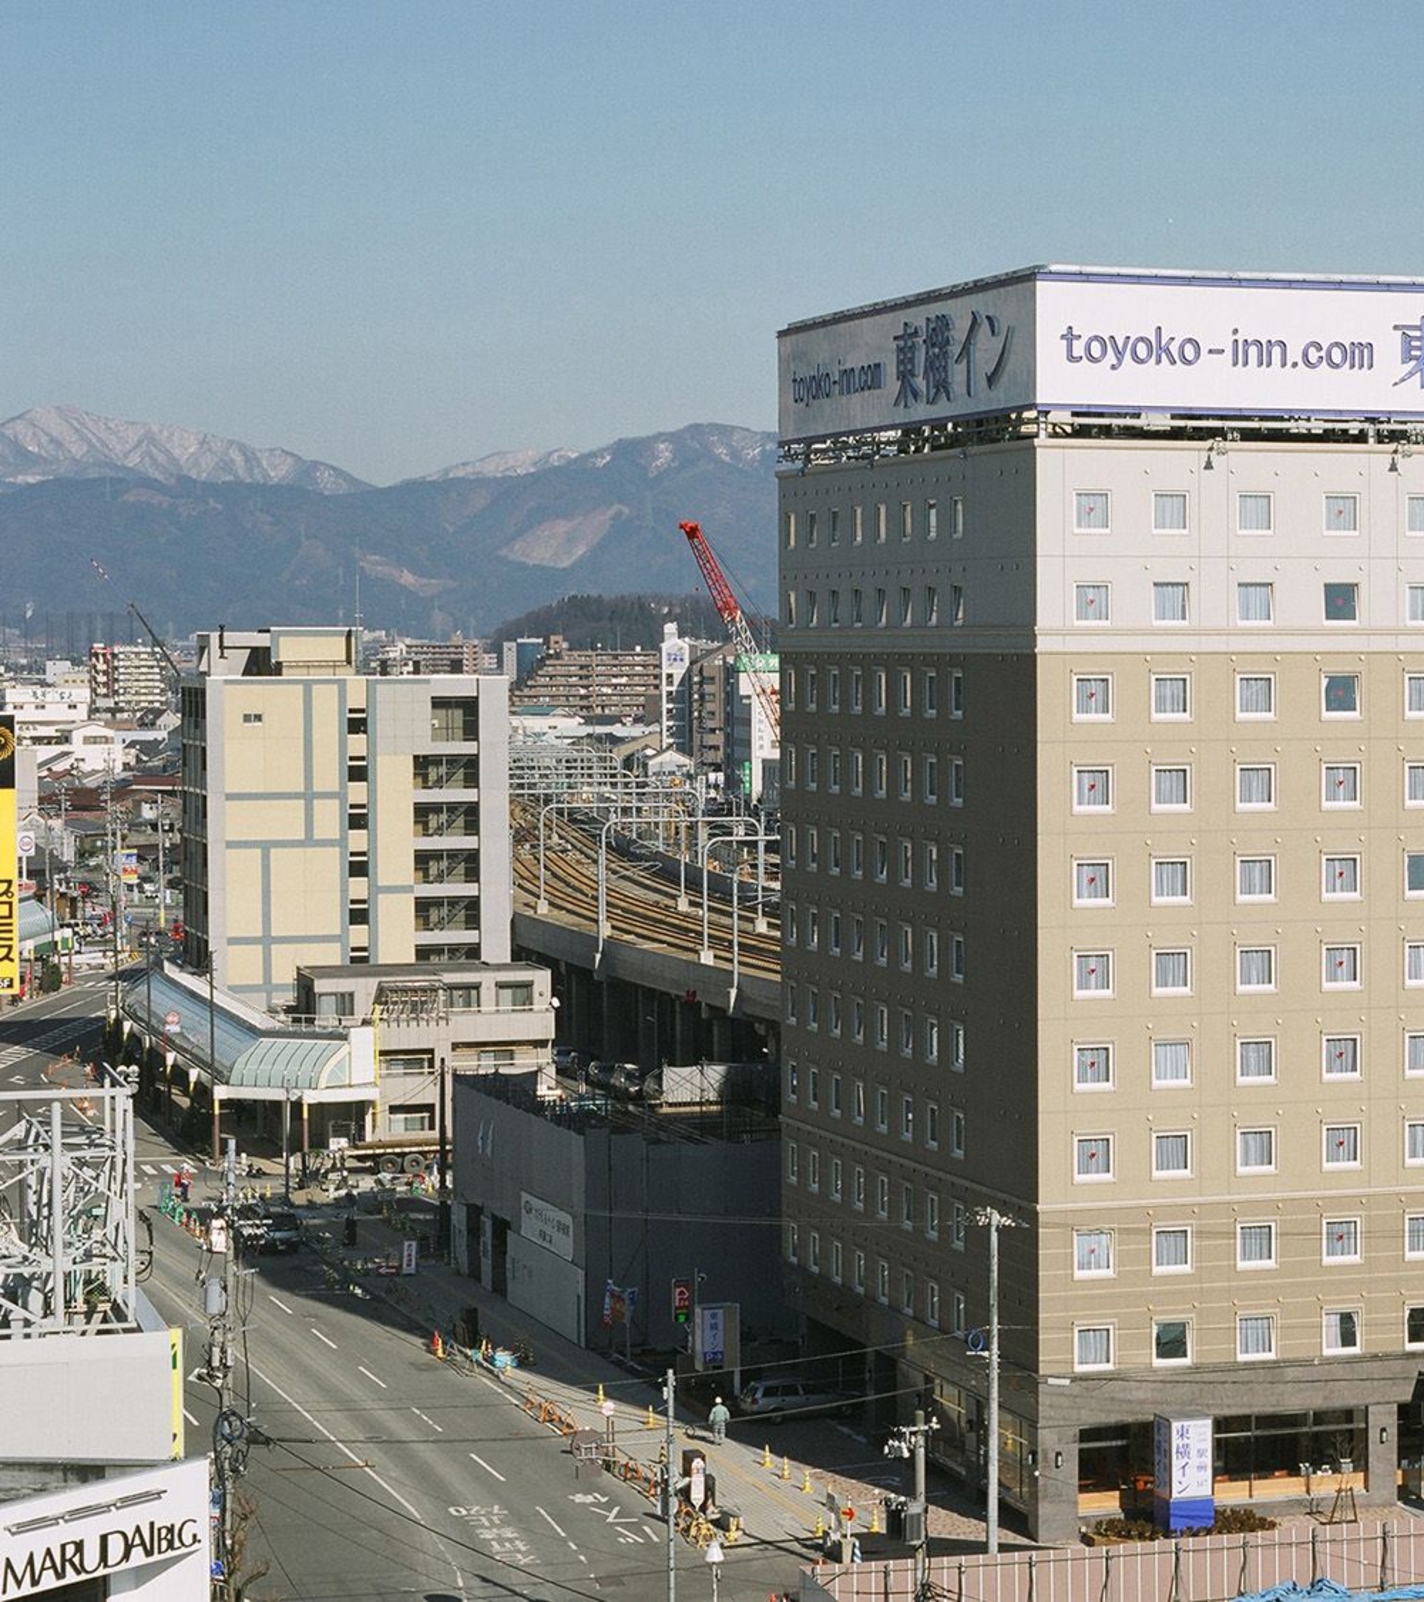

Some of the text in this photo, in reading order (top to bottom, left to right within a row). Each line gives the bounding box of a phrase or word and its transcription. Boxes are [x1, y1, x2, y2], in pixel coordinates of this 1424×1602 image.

[792, 355, 885, 407] toyoko-inn.com
[893, 310, 1013, 409] 東横イン
[1061, 326, 1374, 371] toyoko-inn.com
[1176, 1424, 1191, 1495] 東横イン
[2, 1519, 202, 1595] MARUDAI BLG.
